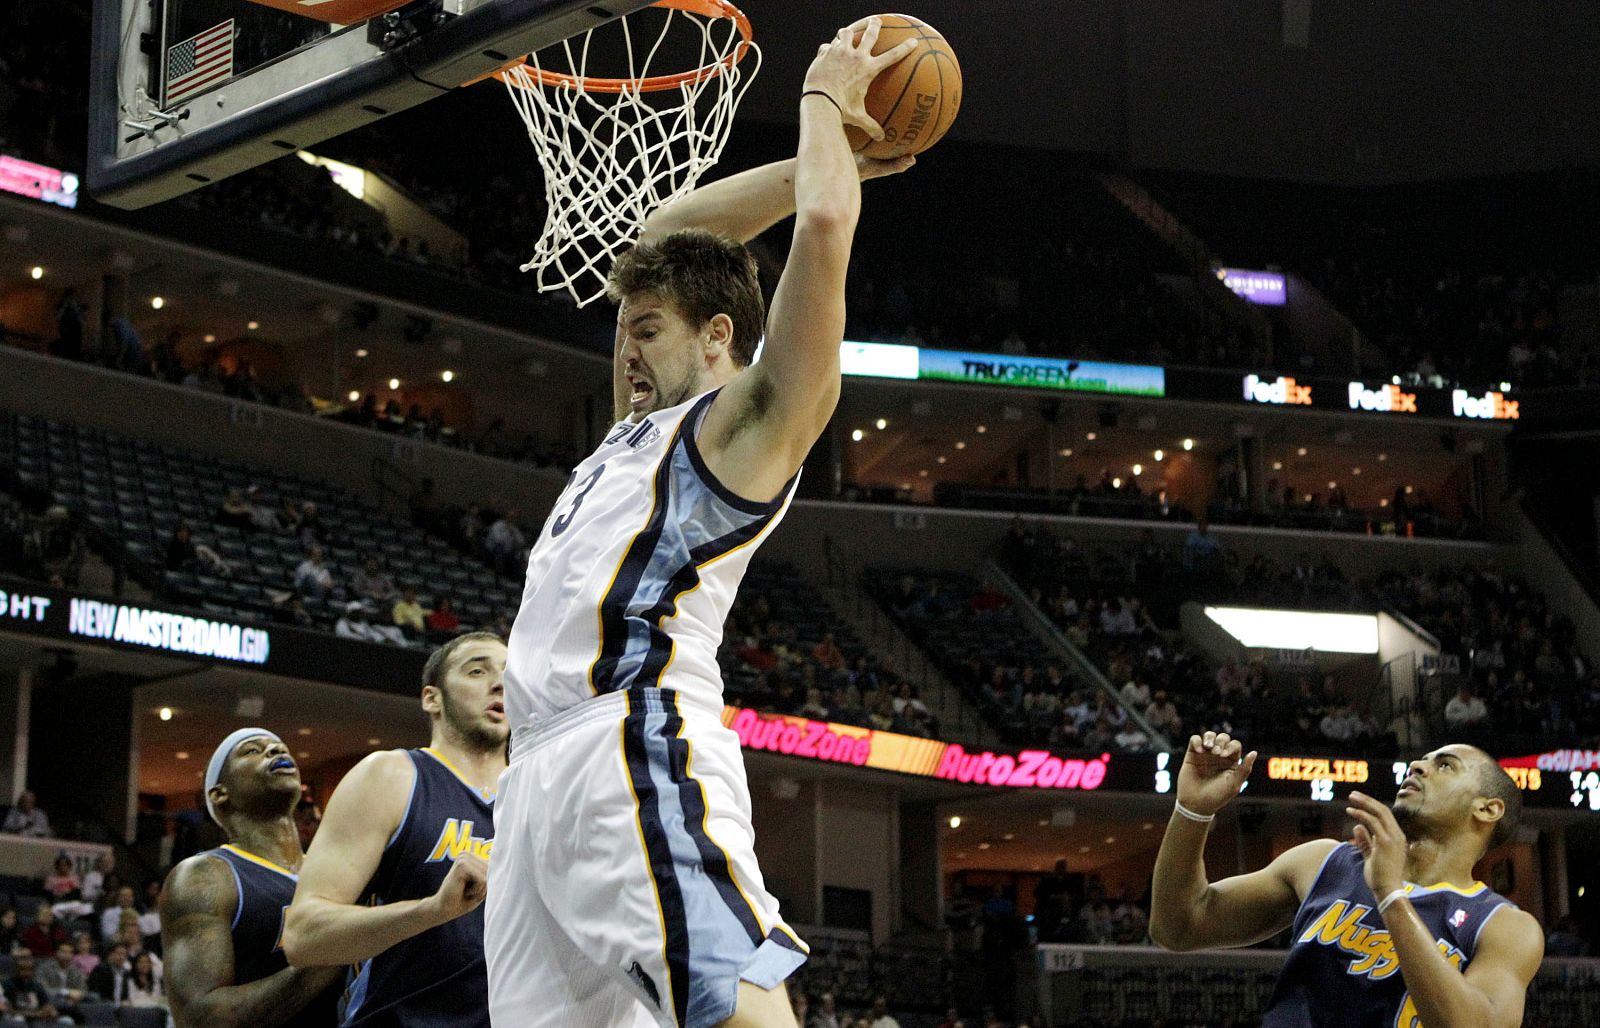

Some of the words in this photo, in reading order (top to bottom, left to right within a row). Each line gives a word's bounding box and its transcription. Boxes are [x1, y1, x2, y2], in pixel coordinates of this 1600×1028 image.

[1243, 374, 1312, 405] FedEx
[1348, 381, 1417, 413] FedEx
[1452, 389, 1520, 419] FedEx
[545, 463, 606, 538] 3
[733, 708, 870, 766] AutoZone
[938, 743, 1108, 790] AutoZone
[1268, 757, 1369, 783] GRIZZLIES
[1310, 778, 1334, 801] 12
